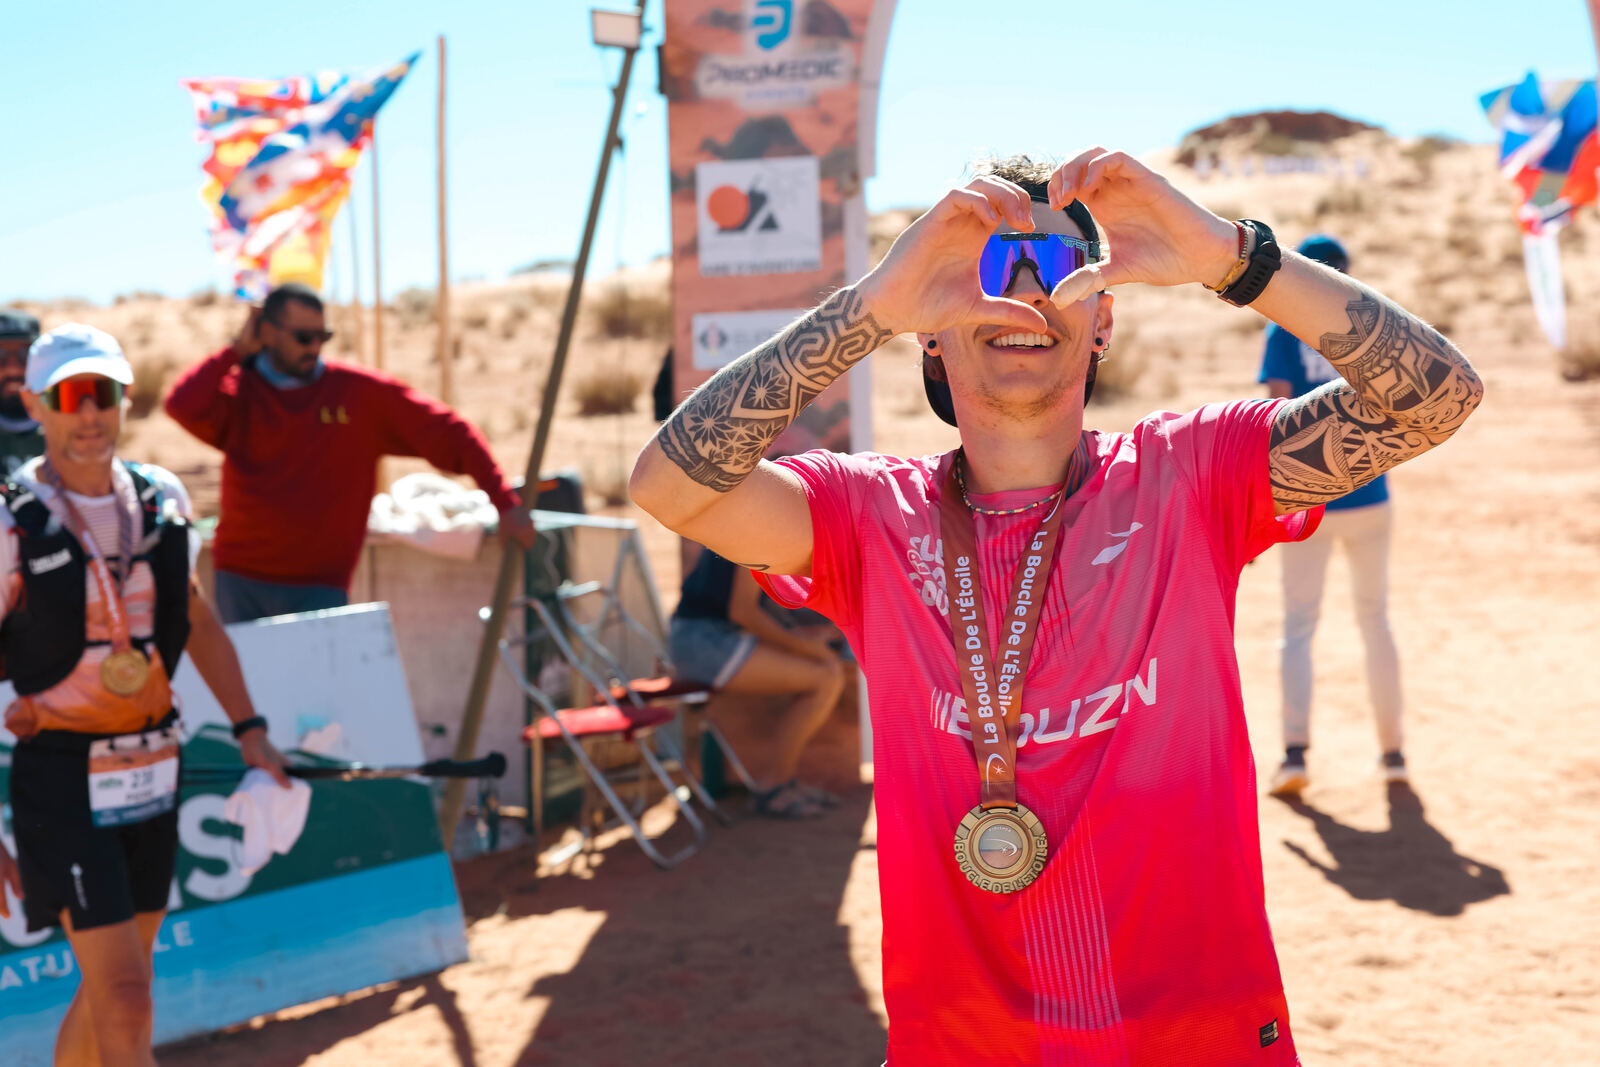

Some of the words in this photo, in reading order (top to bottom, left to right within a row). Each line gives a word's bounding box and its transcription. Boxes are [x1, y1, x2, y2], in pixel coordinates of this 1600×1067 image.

[1031, 531, 1048, 551] La
[954, 556, 976, 621] L'Étoile
[1014, 555, 1042, 617] Boucle
[965, 624, 981, 650] De
[1008, 620, 1027, 646] De
[968, 654, 993, 718] Boucle
[984, 722, 999, 744] La
[954, 842, 991, 893] BOUCLE
[991, 882, 1013, 895] DE
